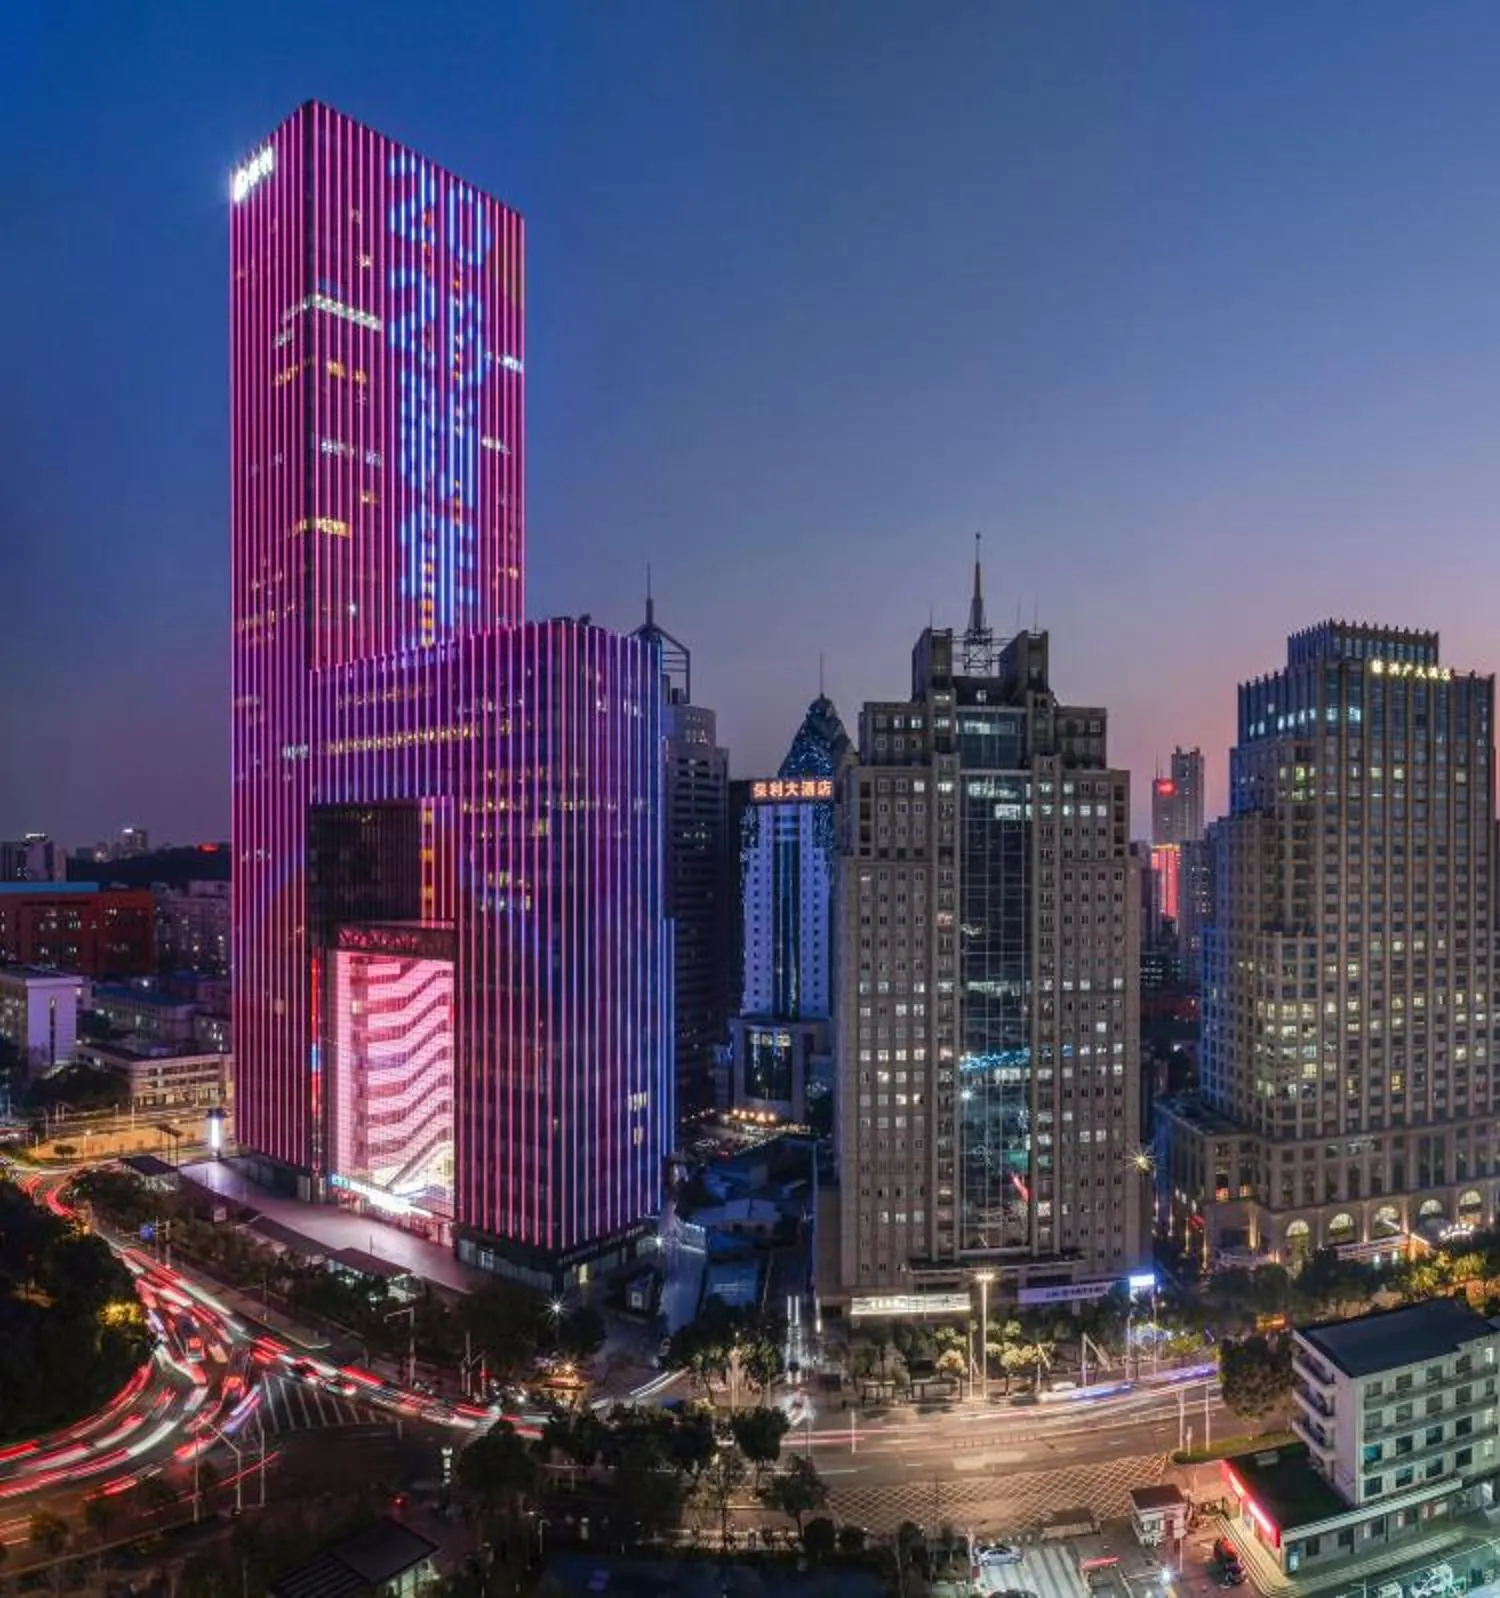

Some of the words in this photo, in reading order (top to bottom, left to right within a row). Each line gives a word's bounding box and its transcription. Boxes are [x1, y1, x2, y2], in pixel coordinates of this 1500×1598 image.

[752, 779, 832, 799] 保利大酒店
